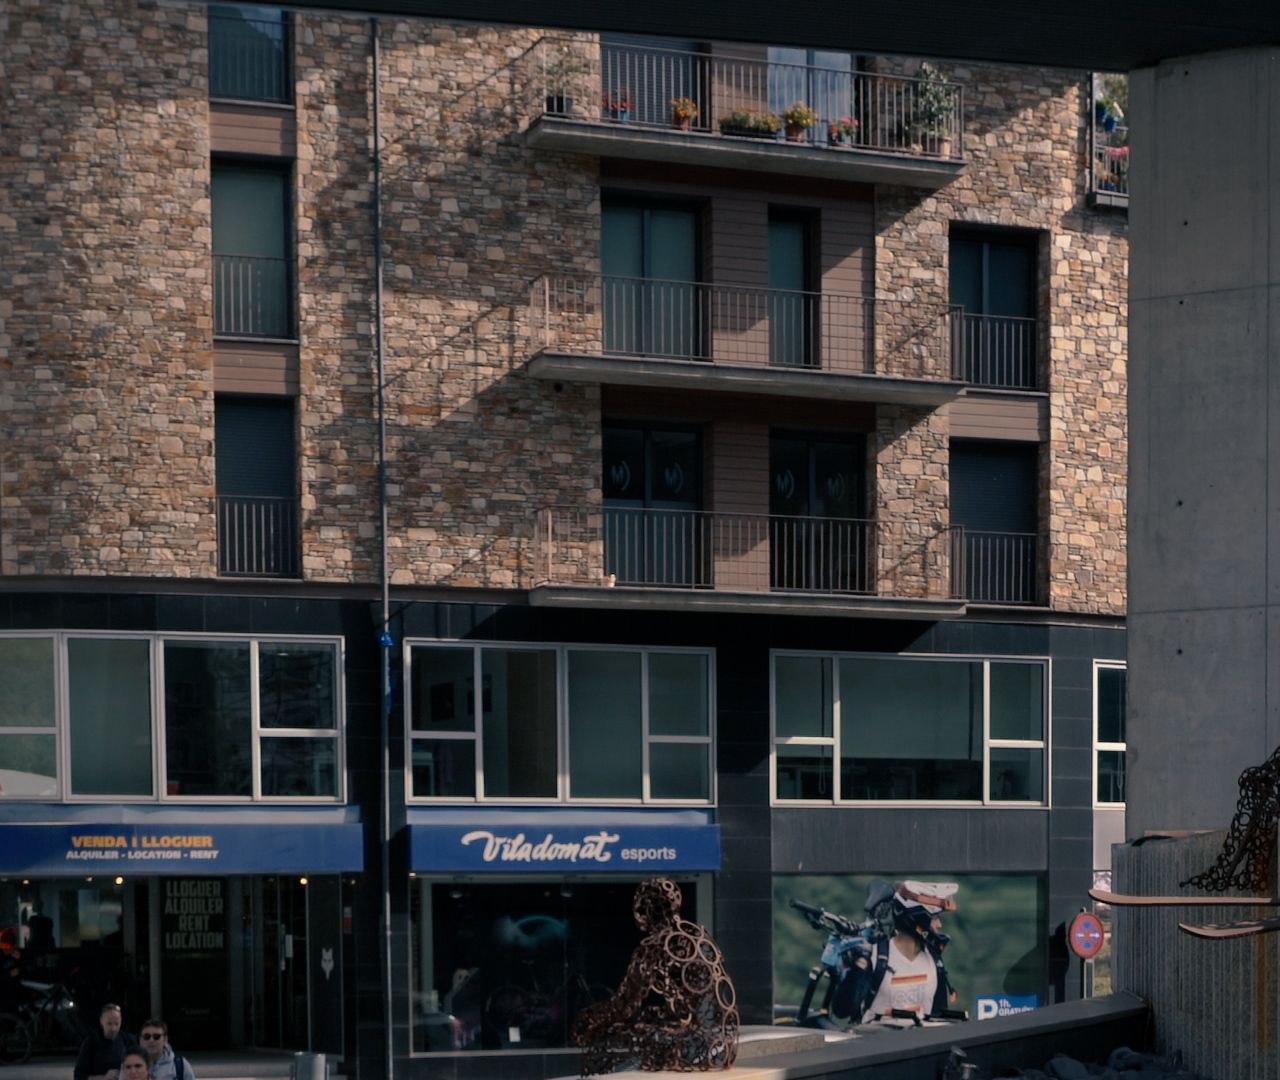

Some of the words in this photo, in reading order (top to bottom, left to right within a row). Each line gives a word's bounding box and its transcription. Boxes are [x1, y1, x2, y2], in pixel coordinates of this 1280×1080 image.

[71, 835, 128, 848] VENDA
[142, 834, 213, 848] LLOGUER
[460, 830, 620, 863] Viladomat
[621, 846, 677, 862] esports
[66, 850, 119, 860] ALQUILER
[127, 850, 181, 859] LOCATION
[190, 850, 219, 859] RENT
[166, 880, 221, 897] LLOGUER
[164, 898, 224, 914] ALQUILER
[178, 915, 210, 931] RENT
[165, 932, 224, 949] LOCATION
[977, 998, 998, 1021] P
